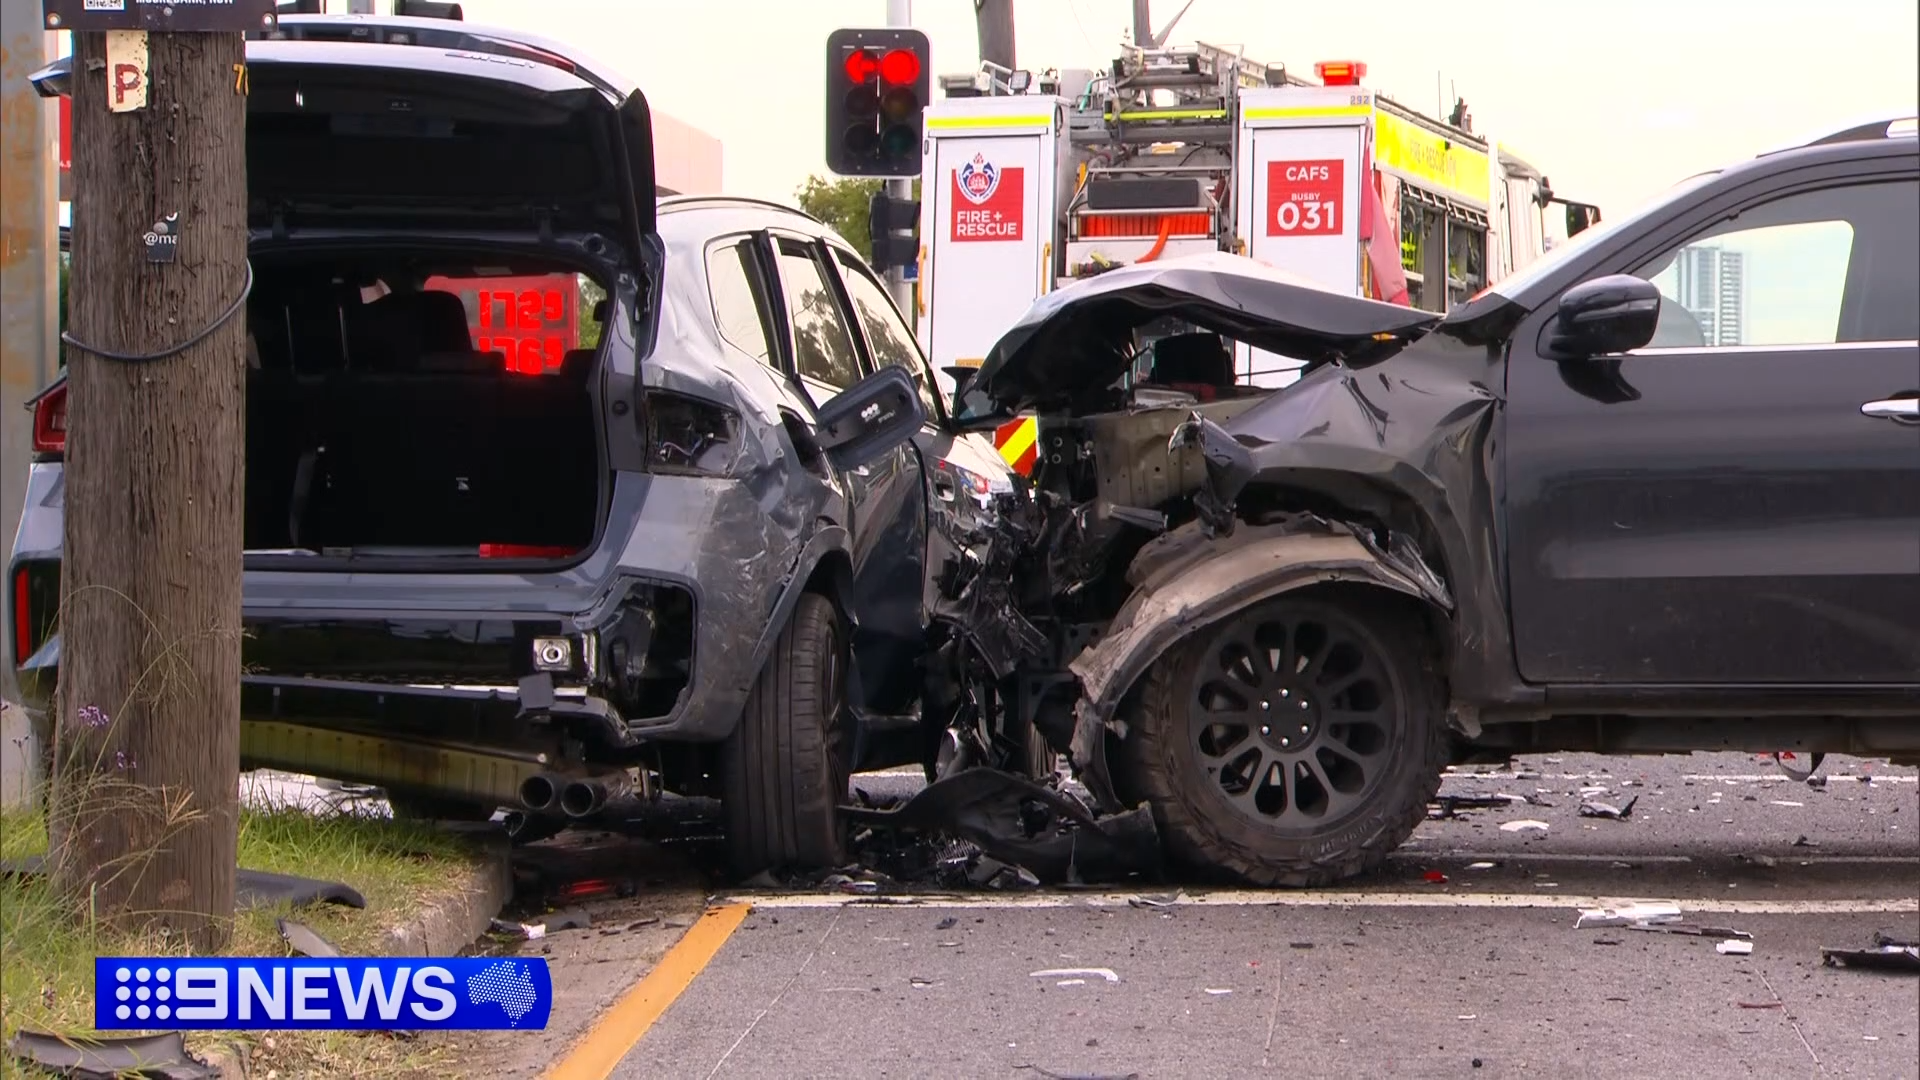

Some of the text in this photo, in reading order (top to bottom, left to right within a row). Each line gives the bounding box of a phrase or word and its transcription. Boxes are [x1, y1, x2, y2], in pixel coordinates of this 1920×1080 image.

[115, 64, 141, 104] P
[1286, 166, 1329, 181] CAFS
[1291, 193, 1320, 201] BUSBY
[956, 210, 991, 223] FIRE
[1277, 201, 1335, 231] 031
[956, 222, 1017, 236] RESCUE
